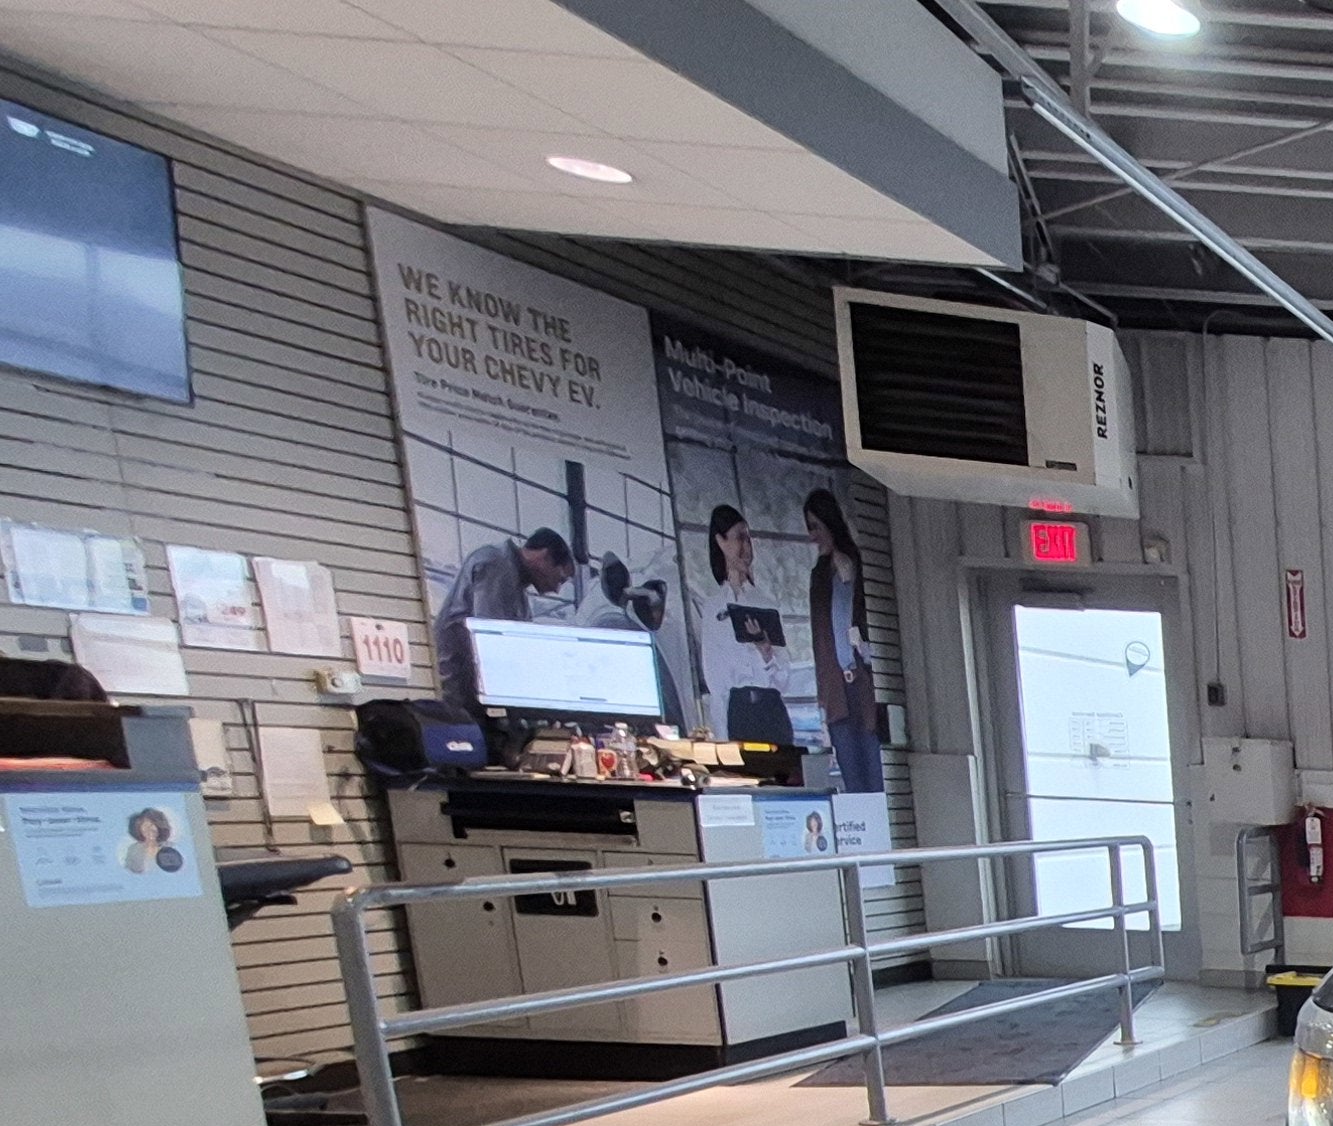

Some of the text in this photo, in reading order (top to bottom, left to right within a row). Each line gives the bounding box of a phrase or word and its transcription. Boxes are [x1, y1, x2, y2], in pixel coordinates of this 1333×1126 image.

[397, 262, 572, 344] WE KNOW THE
[403, 297, 602, 382] RIGHT TIRES FOR
[408, 331, 601, 410] YOUR CHEVY EV.
[664, 335, 772, 394] Multi-Point
[668, 367, 740, 412] Vehicle
[743, 392, 834, 441] Inspection
[1093, 362, 1108, 439] REZNOR
[1031, 523, 1077, 562] EXIT
[362, 634, 405, 664] 1110
[836, 821, 866, 832] rtified
[838, 834, 862, 846] rvice
